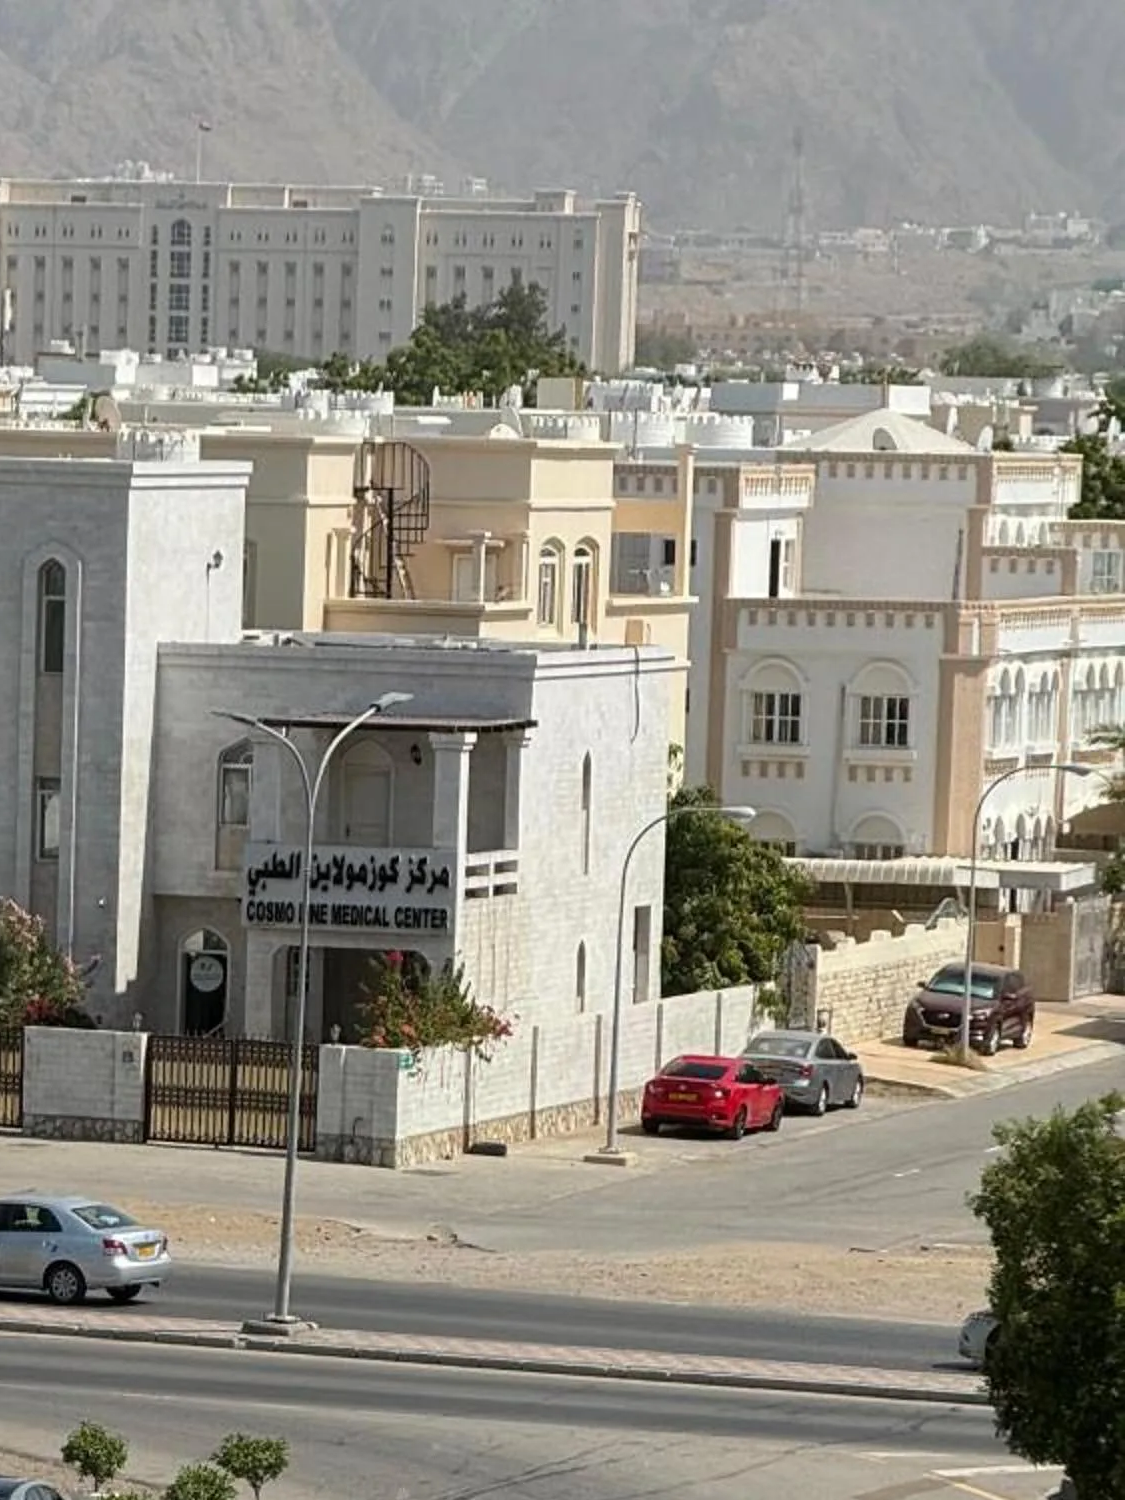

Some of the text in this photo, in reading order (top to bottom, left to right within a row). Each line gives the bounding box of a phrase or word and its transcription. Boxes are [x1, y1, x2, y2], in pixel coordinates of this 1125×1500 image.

[247, 850, 302, 897] الطبي
[405, 855, 451, 894] مركز
[246, 900, 295, 924] COSMO
[331, 904, 390, 928] MEDICAL
[394, 906, 448, 929] CENTER
